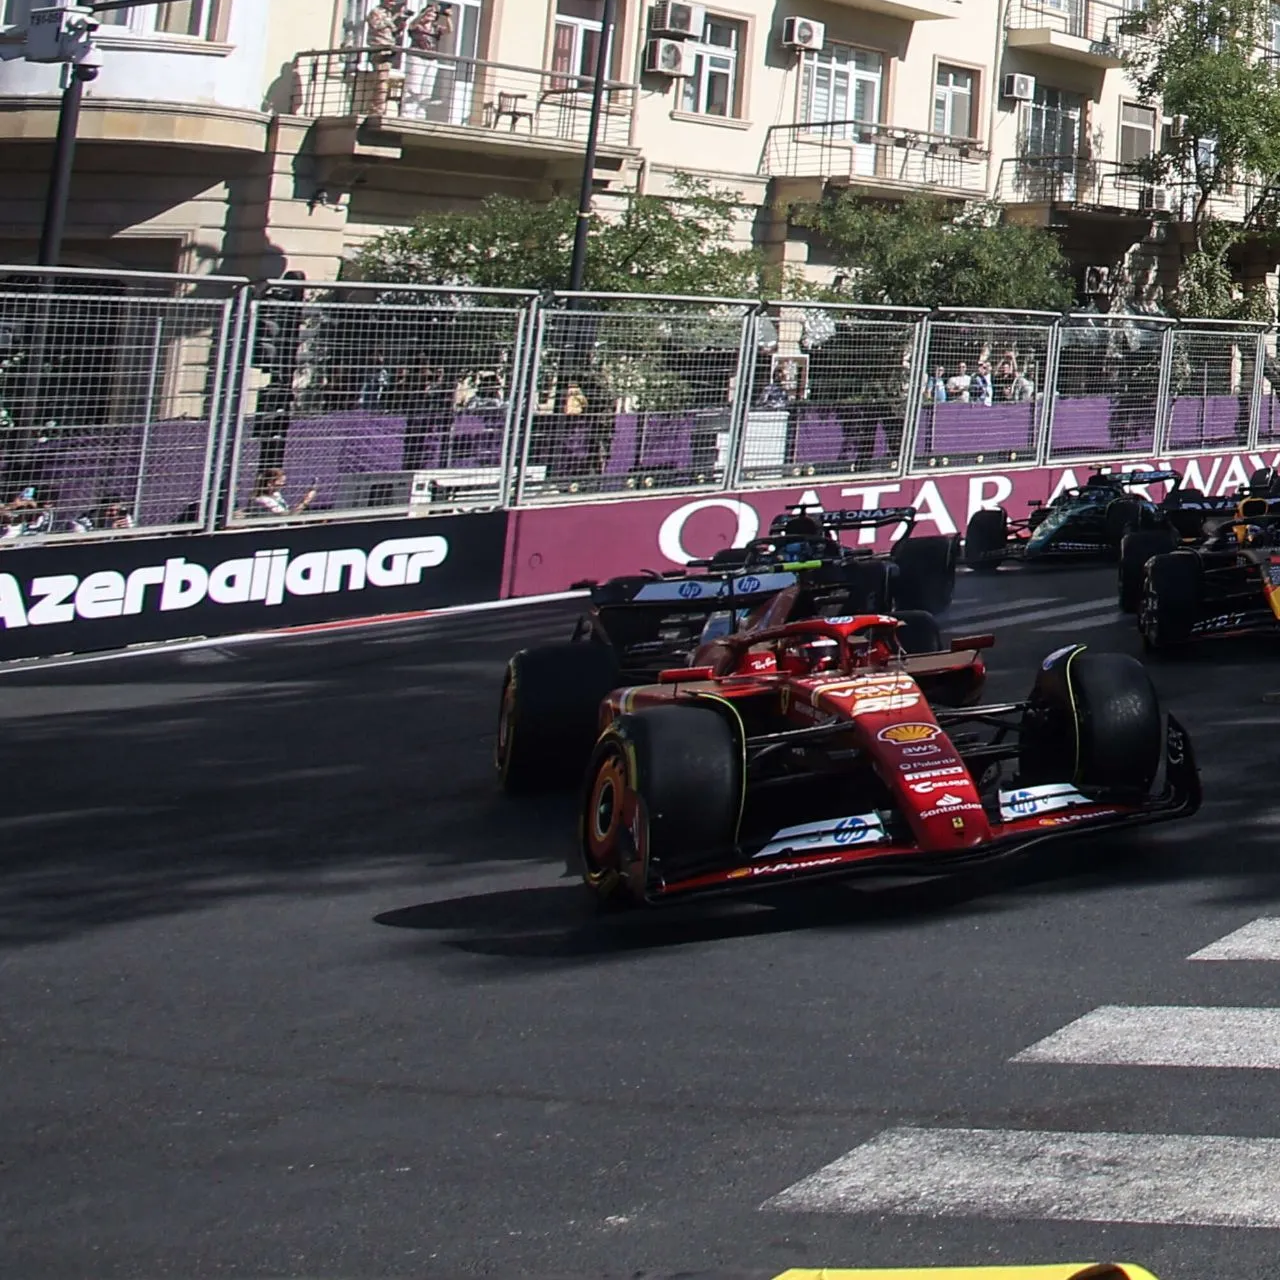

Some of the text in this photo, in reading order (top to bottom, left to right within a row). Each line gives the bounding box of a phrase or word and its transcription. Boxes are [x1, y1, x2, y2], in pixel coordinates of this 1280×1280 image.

[821, 507, 897, 521] TRONAS
[679, 582, 702, 599] hp
[738, 576, 760, 593] hp
[851, 693, 920, 718] 55
[902, 744, 938, 755] aws
[912, 757, 957, 769] Palantir
[919, 802, 983, 819] Santander
[833, 817, 869, 844] hp
[753, 856, 843, 875] V-Power
